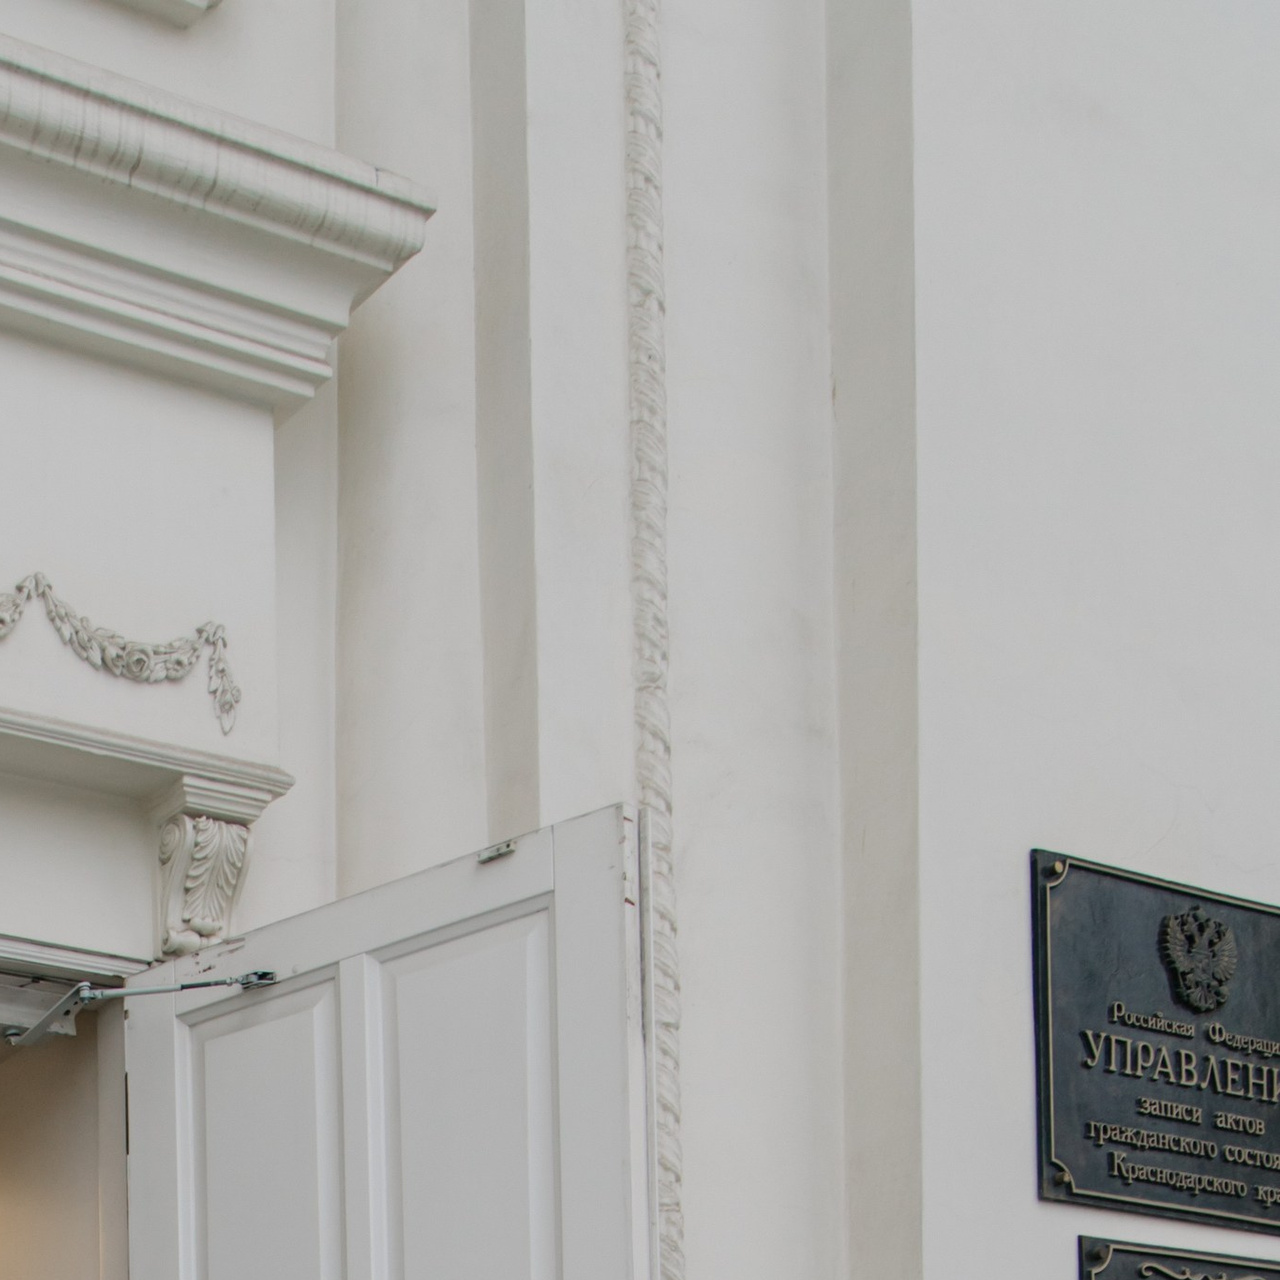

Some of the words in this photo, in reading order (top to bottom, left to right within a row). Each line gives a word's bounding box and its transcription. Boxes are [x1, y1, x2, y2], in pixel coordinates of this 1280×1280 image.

[1112, 1000, 1195, 1037] Российская
[1139, 1097, 1203, 1124] записи
[1215, 1111, 1266, 1136] актов
[1089, 1120, 1218, 1159] гражданского
[1111, 1150, 1247, 1198] Краснодарского
